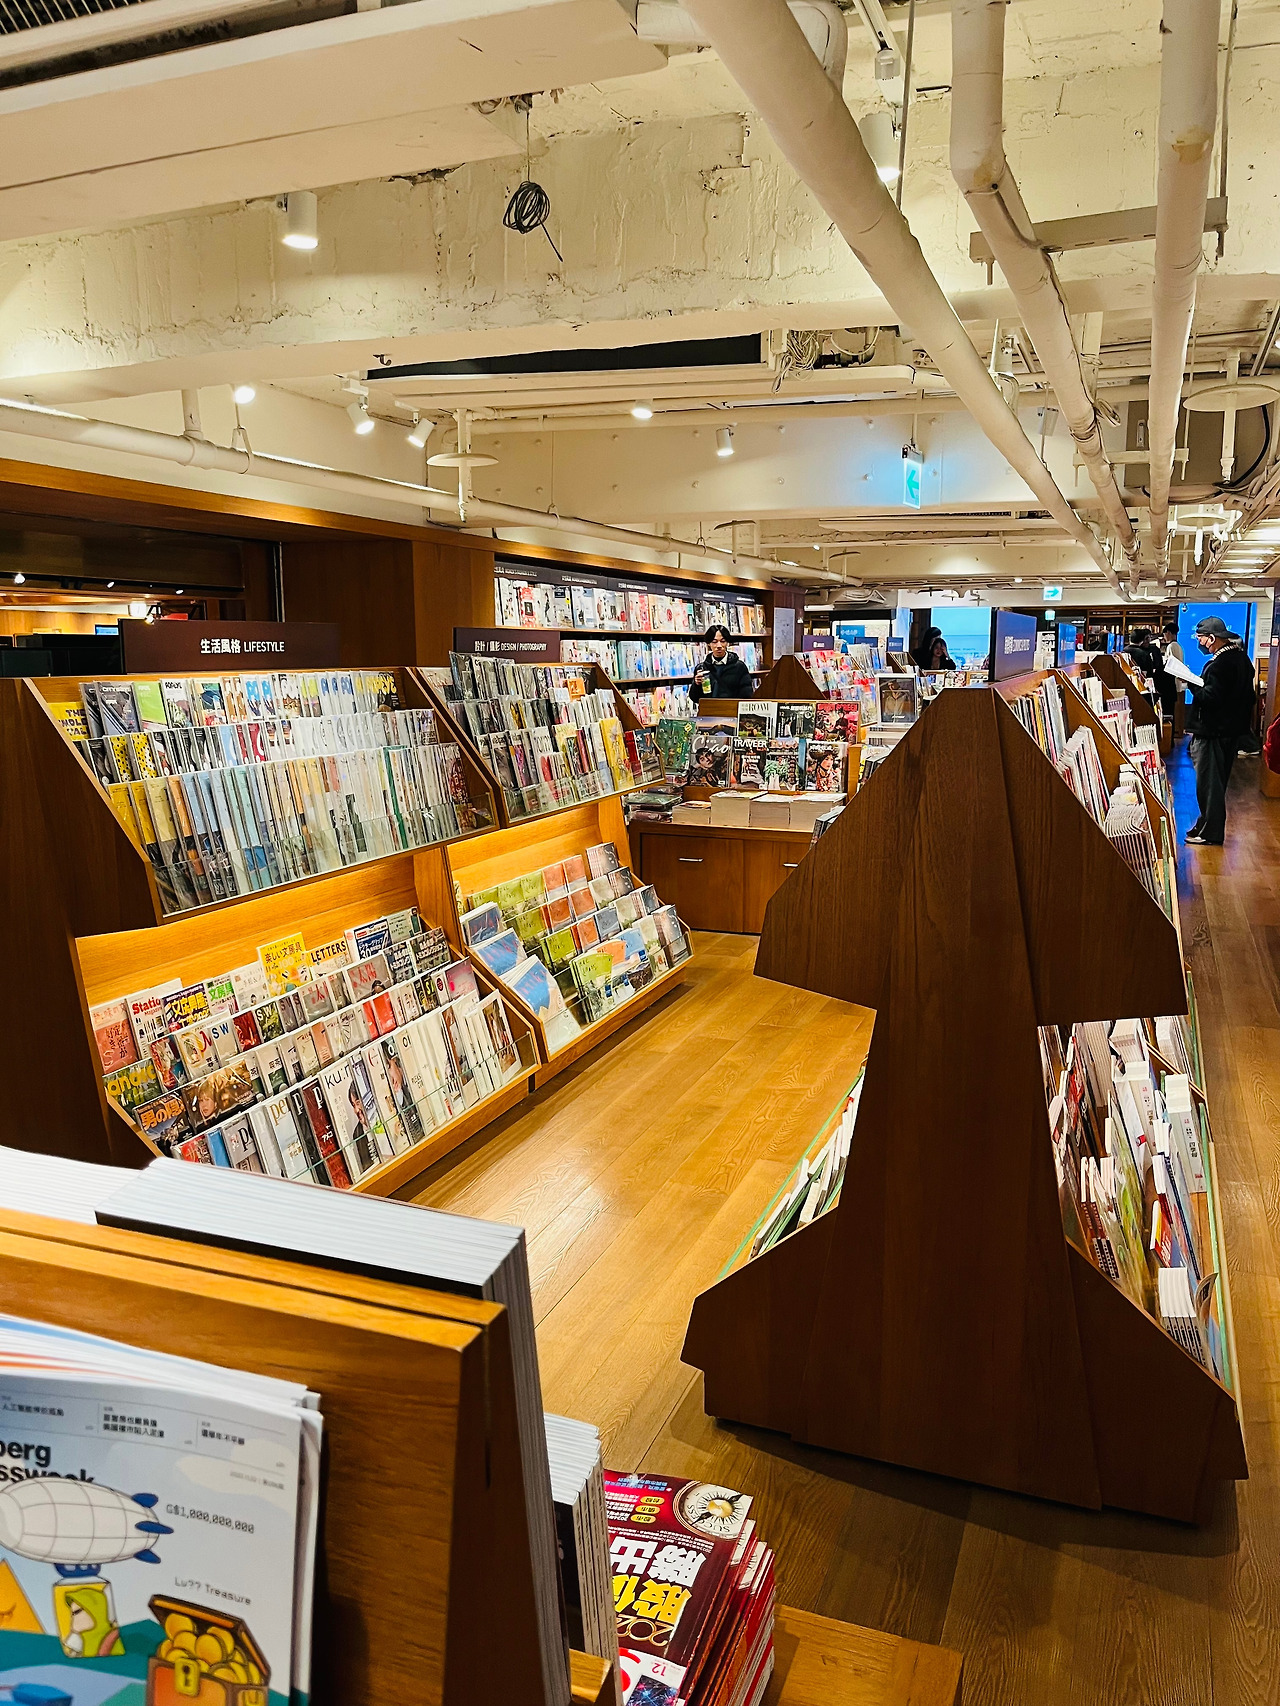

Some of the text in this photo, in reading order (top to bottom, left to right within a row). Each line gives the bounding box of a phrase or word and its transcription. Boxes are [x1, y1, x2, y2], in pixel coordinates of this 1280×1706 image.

[200, 638, 285, 654] 生活風格 LIFESTYLE
[501, 642, 517, 651] DESIGN
[519, 643, 547, 651] PHOTOGRAPHY
[310, 940, 347, 963] LETTERS
[166, 1503, 255, 1535] G$1,000,000,000
[205, 1583, 252, 1606] Treasure
[651, 1663, 667, 1677] 12
